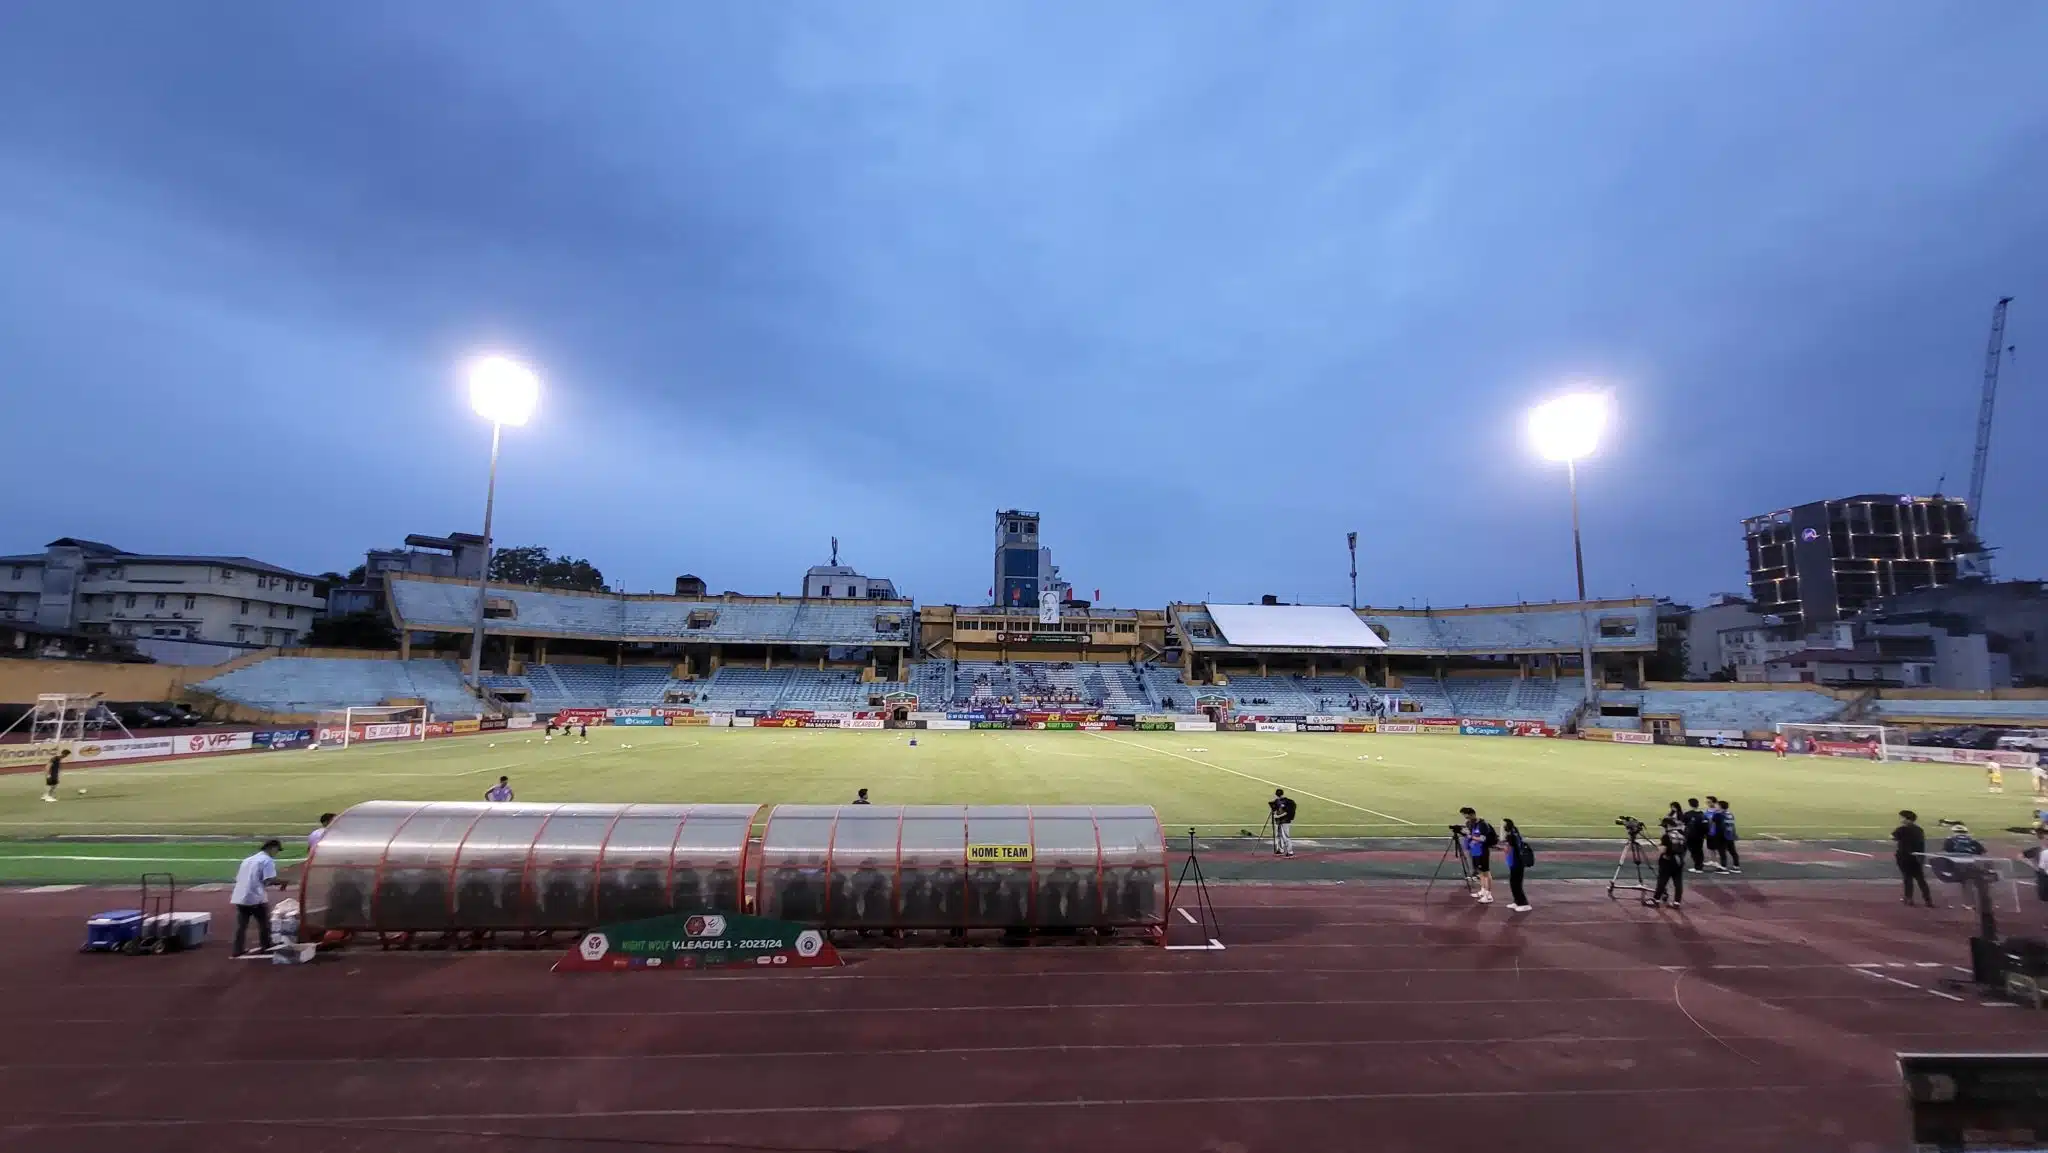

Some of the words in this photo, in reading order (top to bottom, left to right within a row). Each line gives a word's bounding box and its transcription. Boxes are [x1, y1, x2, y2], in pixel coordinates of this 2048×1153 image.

[207, 733, 238, 746] VPF
[971, 847, 999, 858] HOME
[1002, 847, 1028, 858] TEAM
[672, 939, 724, 950] V.LEAGUE
[739, 939, 783, 949] 2023/24
